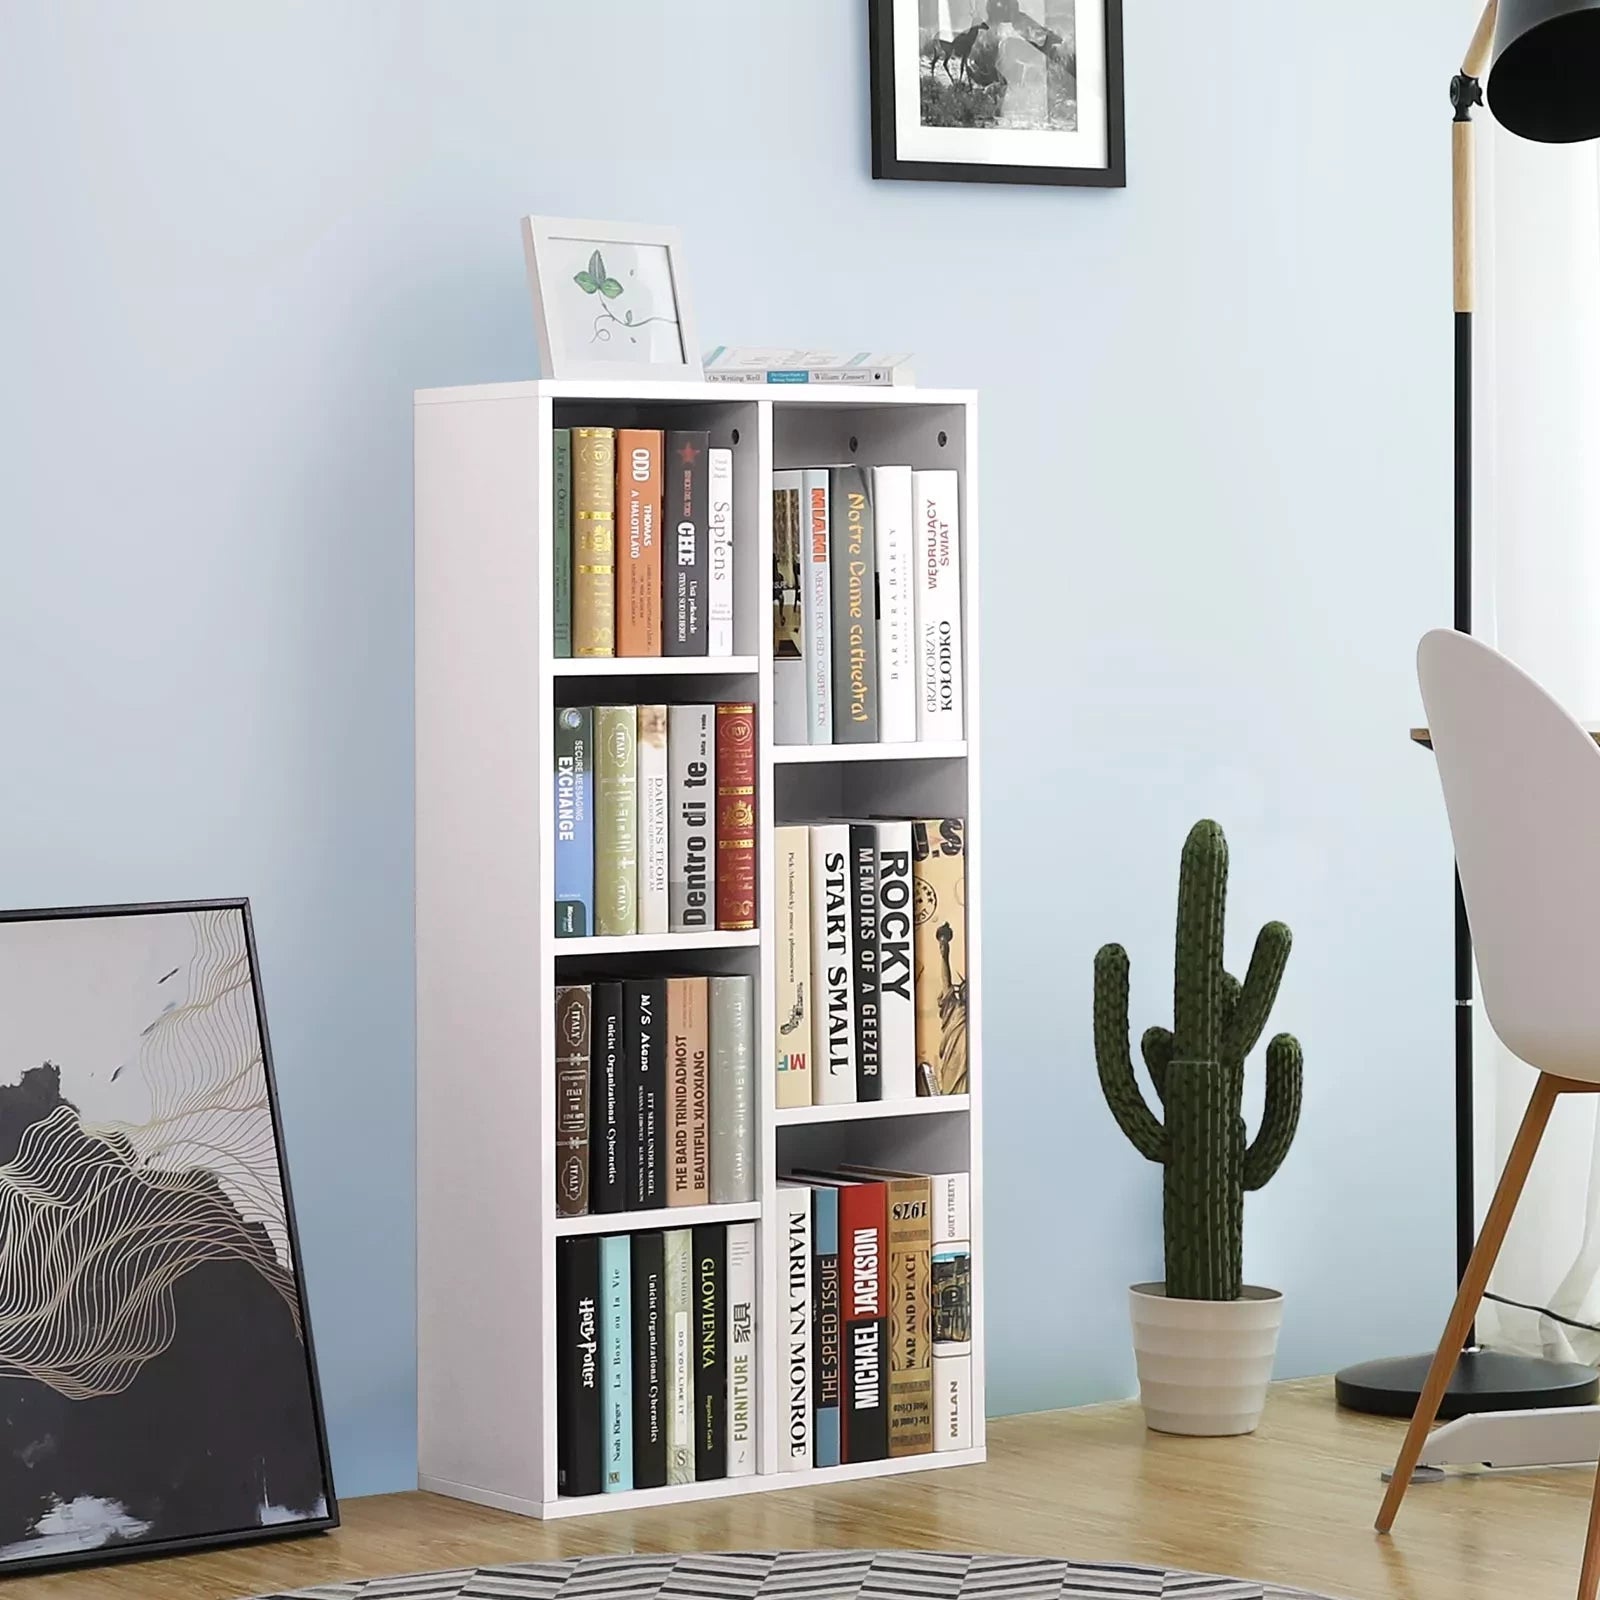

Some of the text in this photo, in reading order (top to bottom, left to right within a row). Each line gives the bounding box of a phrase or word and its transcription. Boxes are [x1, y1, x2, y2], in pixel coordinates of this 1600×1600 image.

[631, 489, 640, 498] A
[632, 448, 650, 481] ODD
[643, 504, 653, 547] THOMAS
[677, 521, 696, 567] CHE
[709, 501, 731, 582] Sapiens
[812, 487, 827, 564] MIAMI
[926, 498, 939, 590] WĘDRUJĄCY
[938, 521, 951, 568] ŚWIAT
[814, 569, 825, 608] MEGAN
[847, 492, 869, 723] Notre Dame cathedral
[816, 636, 826, 658] RED
[816, 660, 827, 699] CARPET
[937, 619, 953, 713] KOŁODKO
[574, 739, 584, 822] SECURE MESSAGING
[615, 731, 627, 760] ITALY
[557, 755, 574, 841] EXCHANGE
[654, 777, 665, 893] DARWINS TEORI
[682, 761, 708, 927] Dentro di te
[824, 852, 850, 1077] START SMALL
[859, 847, 878, 1078] MEMOIRS OF A GEEZER
[879, 850, 911, 1002] ROCKY
[571, 1010, 582, 1040] ITALY
[640, 993, 653, 1026] M/S
[605, 1015, 617, 1185] Unicist Organizational Cybernetics
[674, 1034, 688, 1128] TRINIDADMOST
[693, 1050, 706, 1191] BEAUTIFUL XIAOXIANG
[569, 1164, 580, 1194] ITALY
[647, 1138, 655, 1169] UNDER
[675, 1129, 688, 1165] BARD
[675, 1166, 689, 1192] THE
[946, 1178, 957, 1237] QUIET STREETS
[576, 1297, 598, 1389] Harry Potter
[701, 1256, 716, 1370] GLOWIENKA
[733, 1302, 751, 1345] 家具
[789, 1211, 807, 1458] MARILYN MONROE
[821, 1259, 838, 1402] THE SPEED ISSUE
[853, 1227, 879, 1410] MICHAEL JACKSON
[903, 1253, 917, 1370] WAR AND PEACE
[647, 1273, 660, 1444] Unicist Organizational Cybernetics
[678, 1376, 686, 1401] LIKE
[734, 1354, 748, 1443] FURNITURE
[949, 1380, 960, 1438] MILAN
